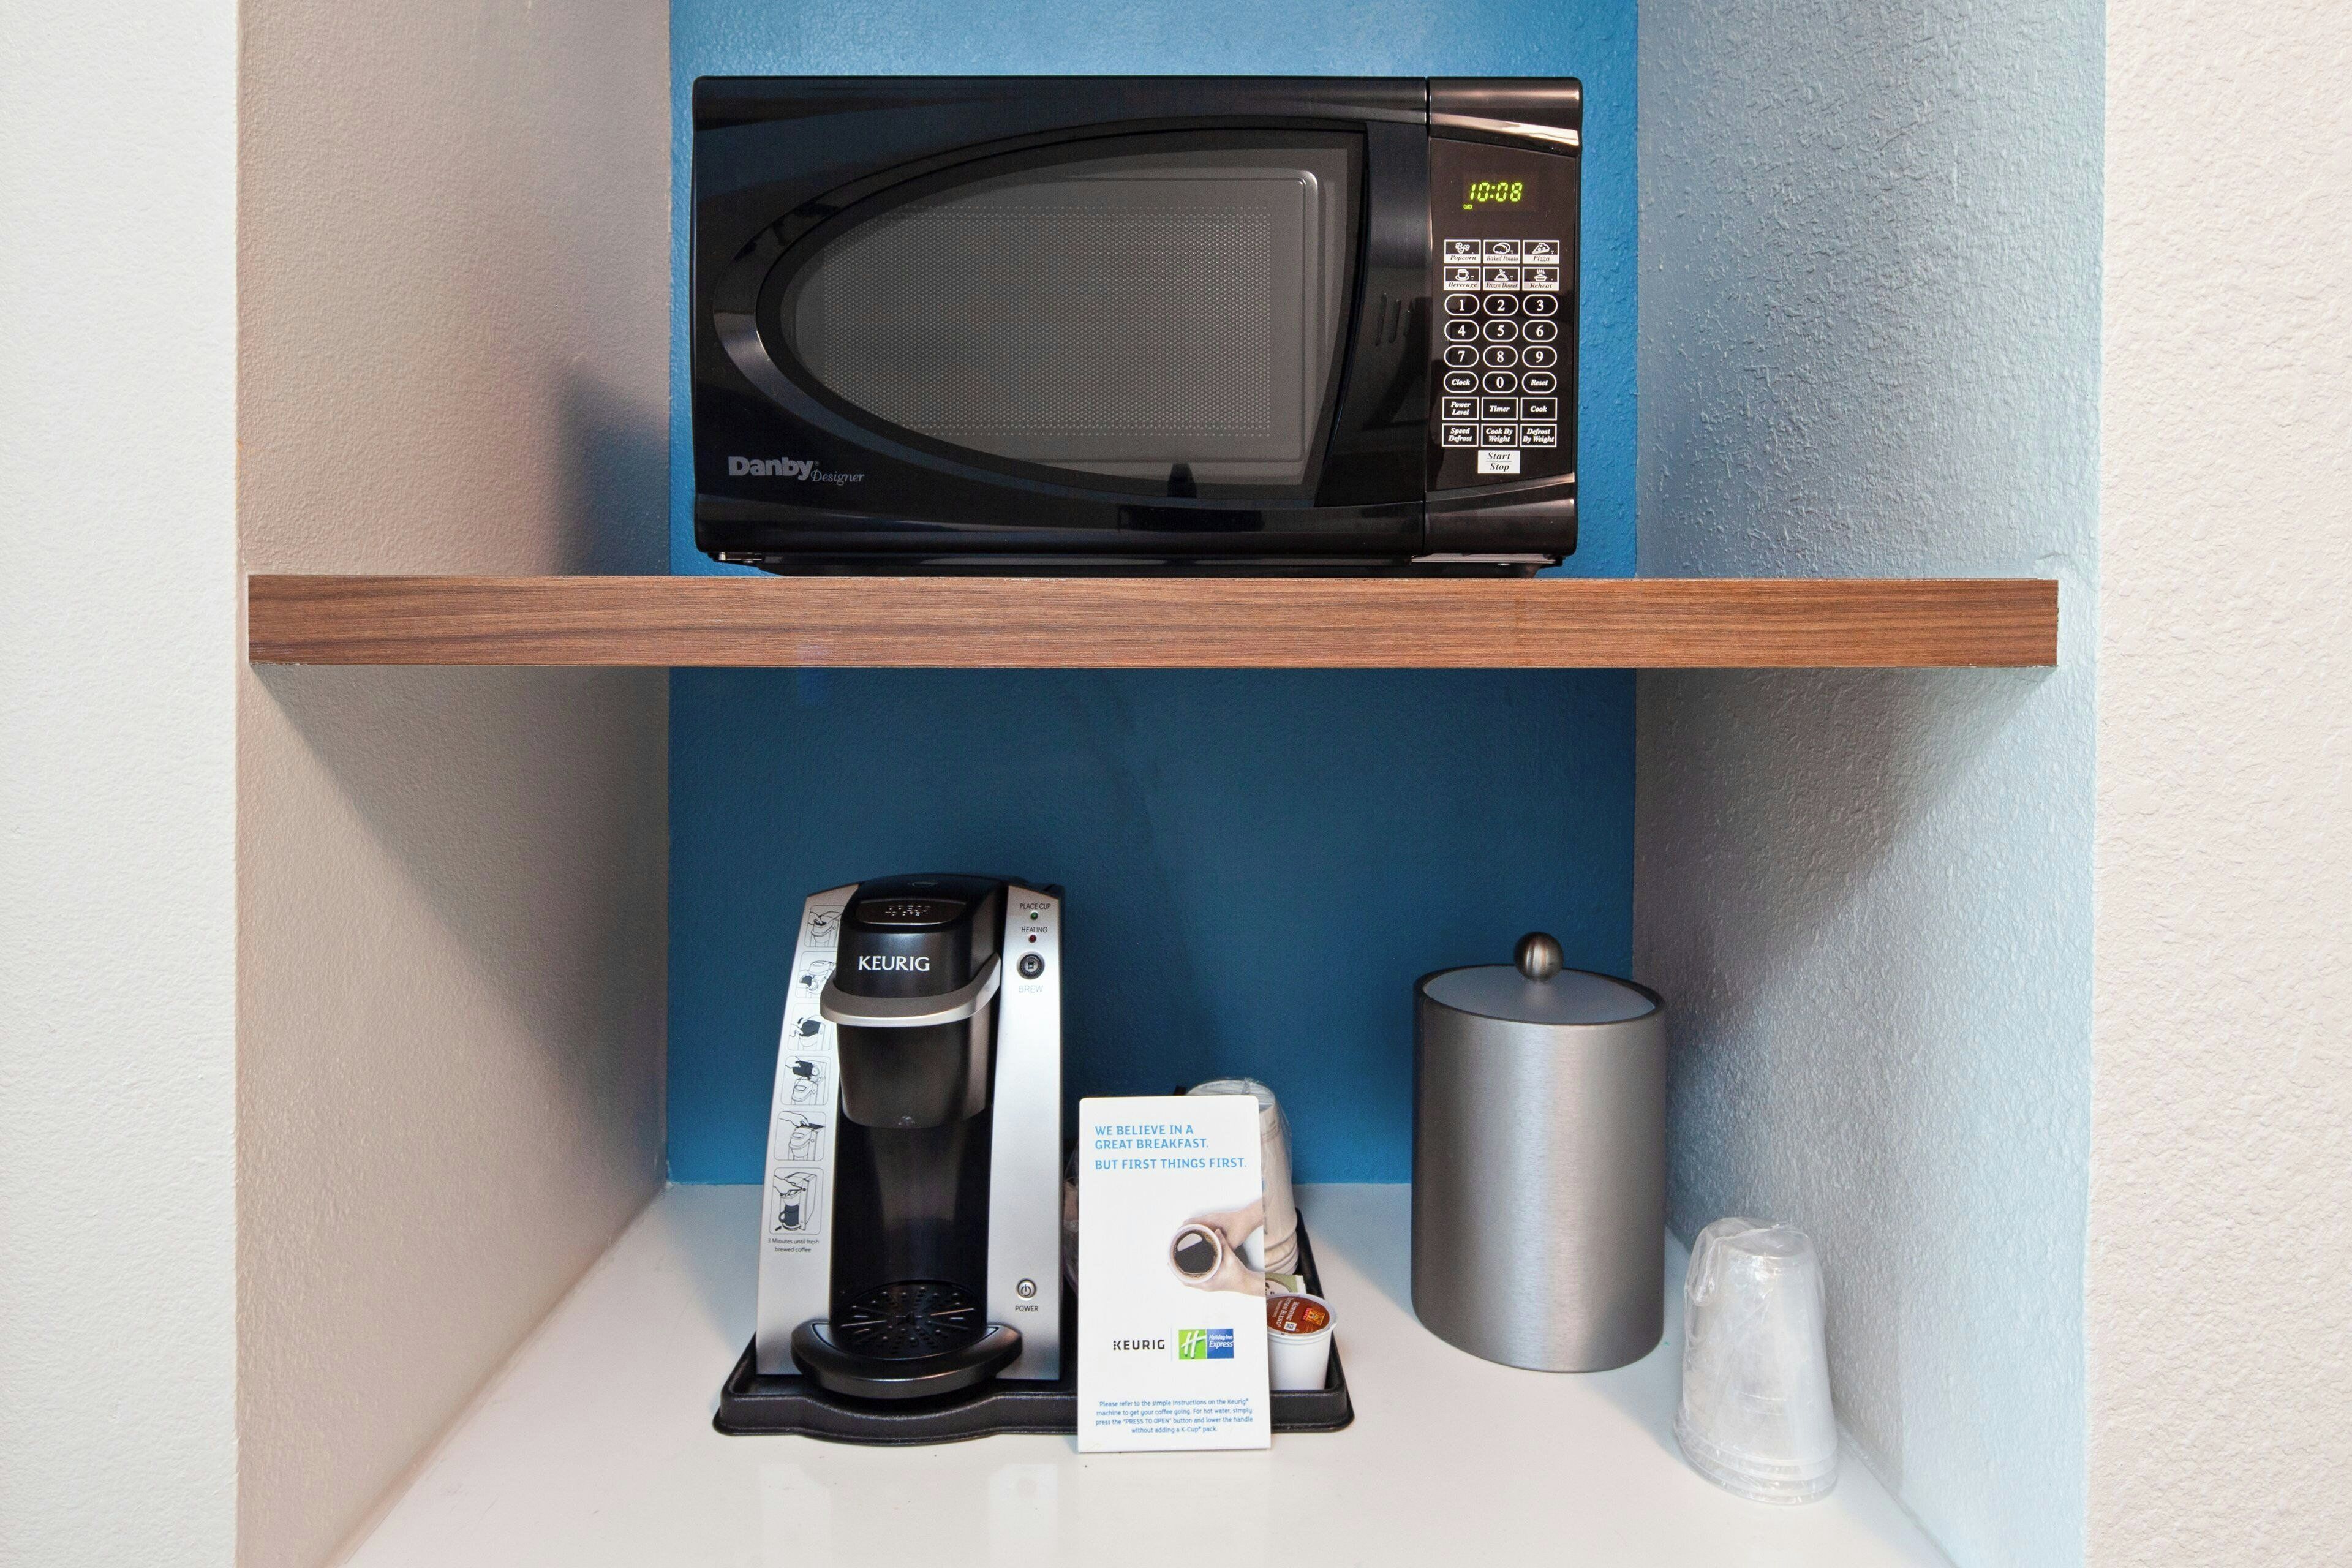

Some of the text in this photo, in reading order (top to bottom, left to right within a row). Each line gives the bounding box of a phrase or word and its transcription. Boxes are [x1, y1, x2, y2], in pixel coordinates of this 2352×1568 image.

[1470, 183, 1522, 202] 10:08
[1459, 300, 1464, 311] 1
[1497, 300, 1505, 311] 2
[1537, 300, 1544, 311] 3
[1458, 325, 1466, 336] 4
[1497, 325, 1504, 336] 5
[1536, 325, 1544, 337] 6
[1457, 350, 1465, 362] 7
[1496, 351, 1504, 363] 8
[1536, 351, 1544, 363] 9
[1496, 377, 1504, 388] 0
[1487, 451, 1510, 460] Start
[1490, 462, 1509, 472] Stop
[810, 469, 865, 486] Designer
[858, 956, 930, 971] KEURIG
[1095, 1125, 1194, 1136] WE BELIEVE IN A
[1095, 1138, 1209, 1149] GREAT BREAKFAST.
[1095, 1158, 1247, 1170] BUT FIRST THINGS FIRST.
[1114, 1340, 1165, 1351] KEURIG
[1209, 1340, 1233, 1349] Express
